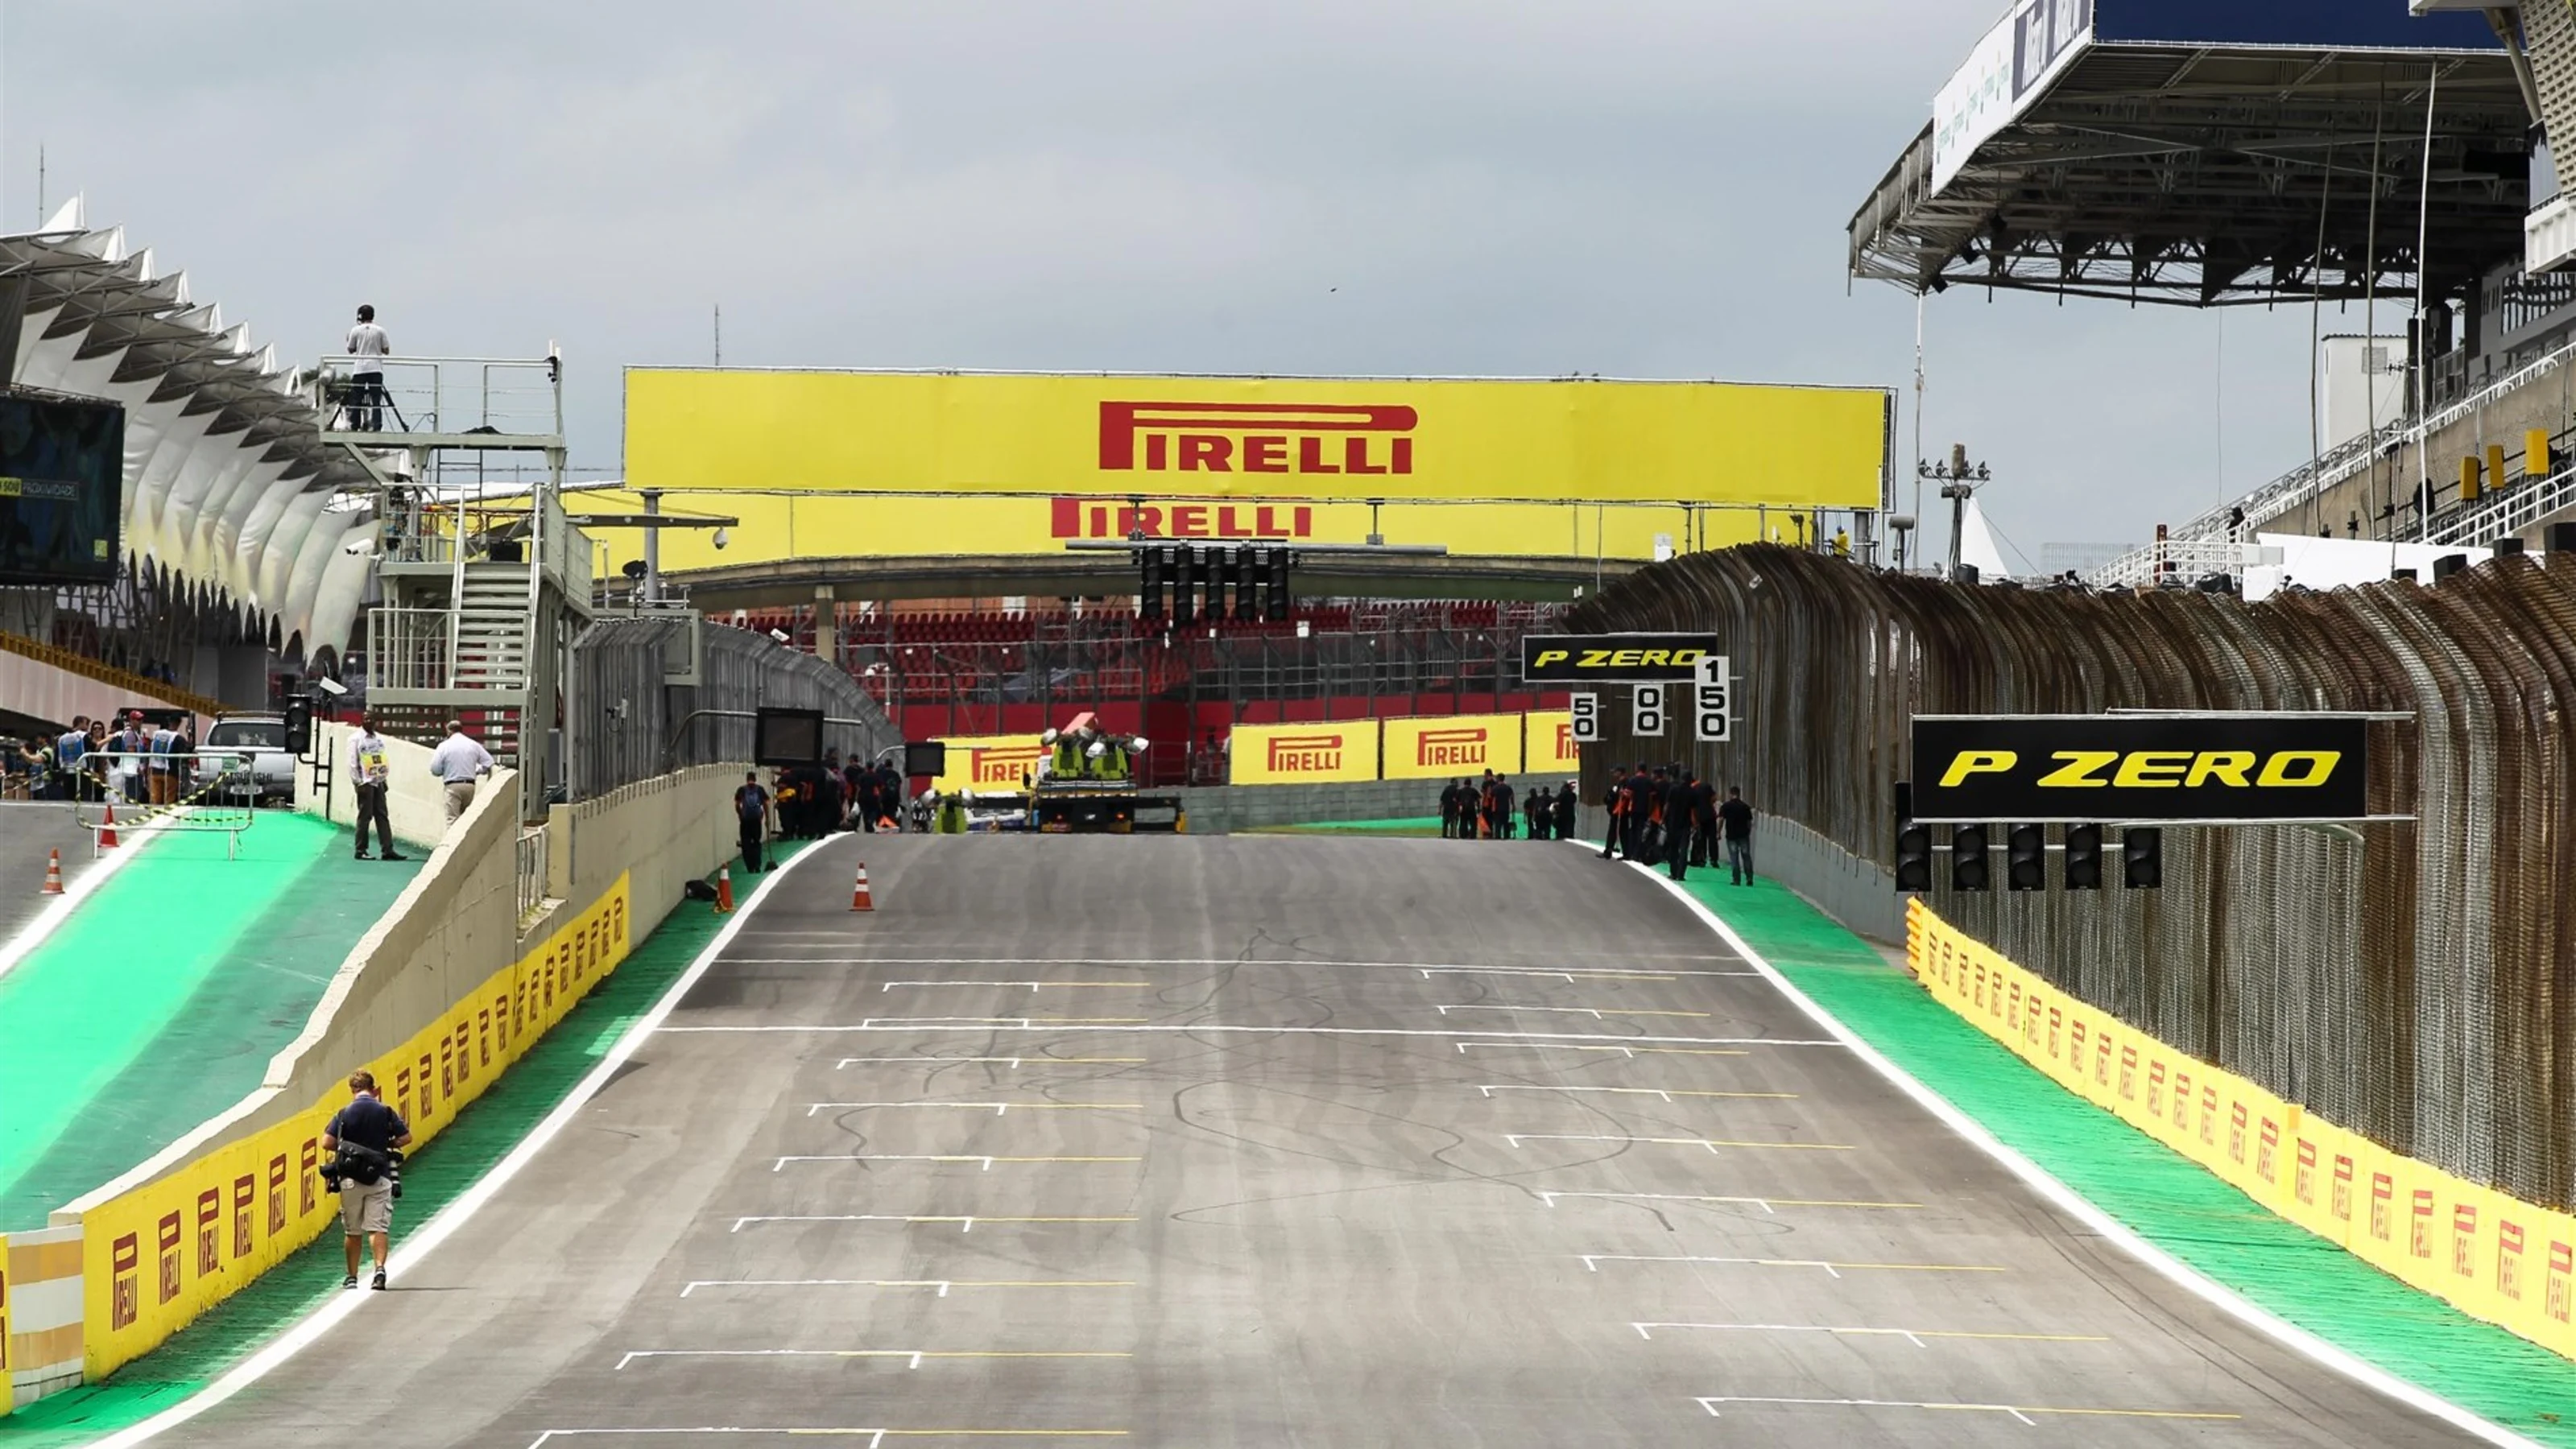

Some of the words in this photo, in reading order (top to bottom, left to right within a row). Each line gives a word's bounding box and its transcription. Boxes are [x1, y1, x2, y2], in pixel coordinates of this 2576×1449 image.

[1098, 401, 1418, 474] PIRELLI
[1534, 650, 1569, 667] P
[1577, 650, 1706, 667] ZERO
[1268, 734, 1342, 771] PIRELLI
[1417, 728, 1487, 766] PIRELLI
[1939, 750, 2017, 787] P
[2036, 750, 2341, 787] ZERO
